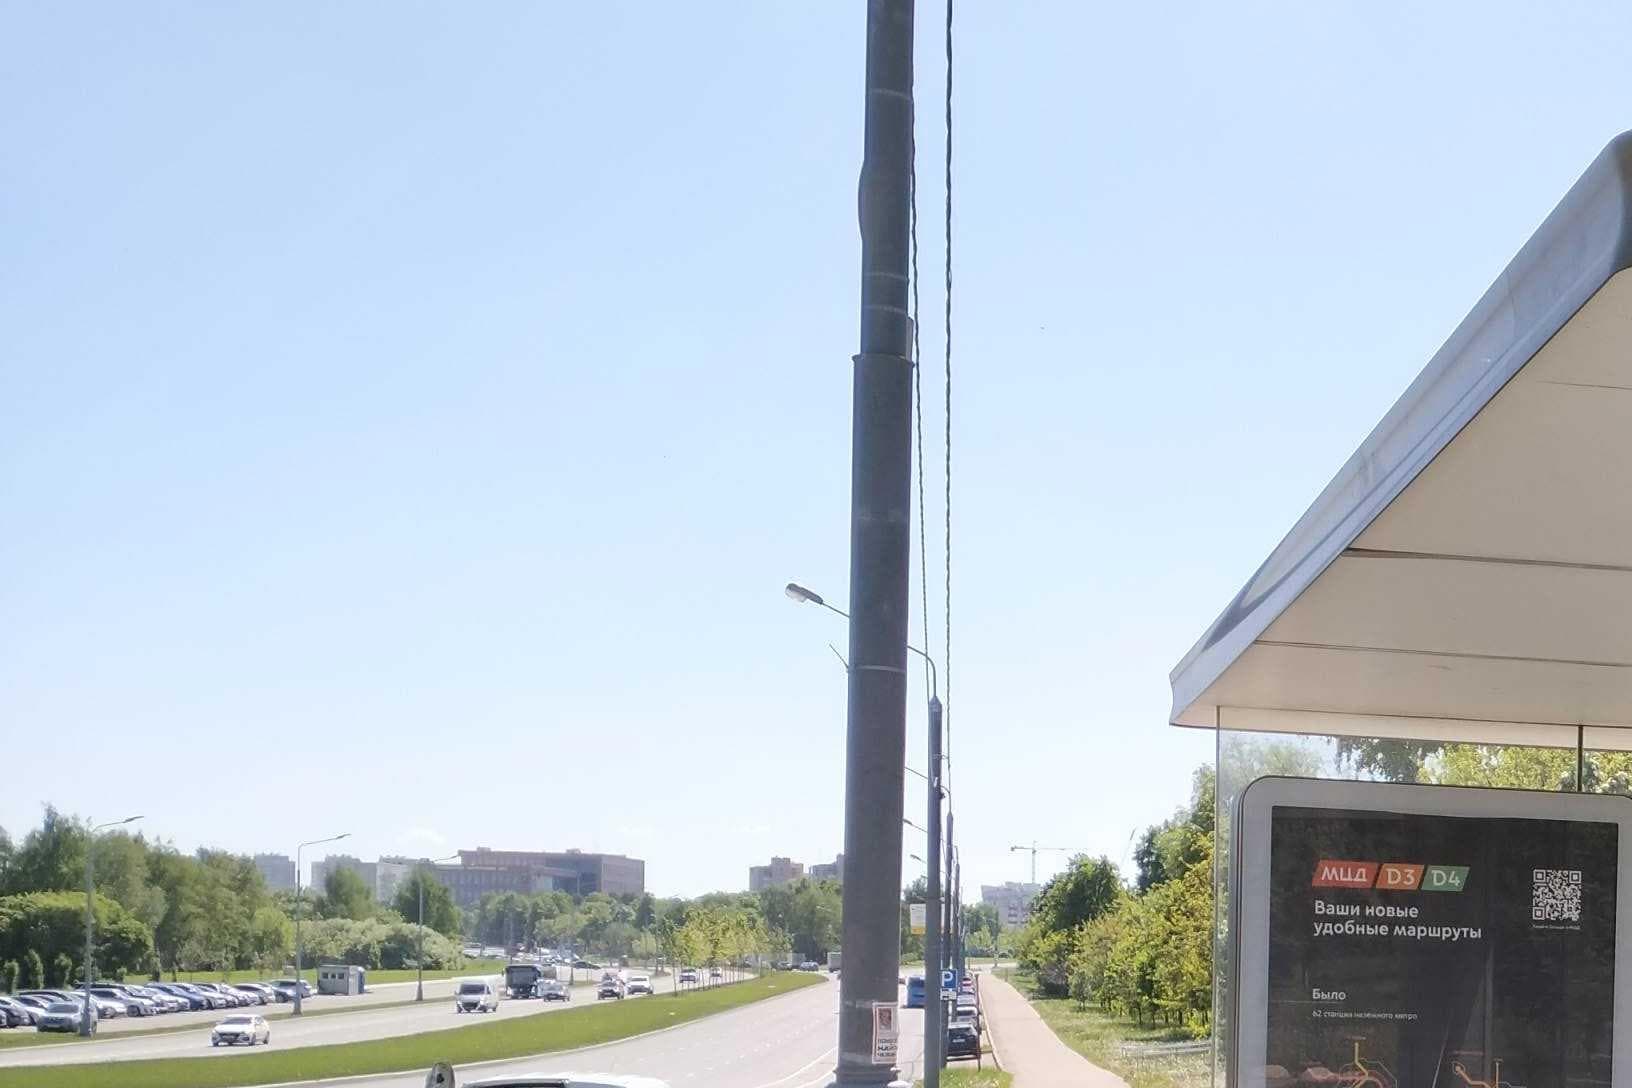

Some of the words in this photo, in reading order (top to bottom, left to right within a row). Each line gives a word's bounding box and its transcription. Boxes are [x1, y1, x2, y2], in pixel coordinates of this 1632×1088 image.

[1320, 866, 1367, 882] МЦД
[1385, 868, 1415, 885] D3
[1431, 869, 1460, 886] D4
[1314, 900, 1360, 916] Ваши
[1365, 905, 1419, 918] новые
[1313, 920, 1389, 936] удобные
[1393, 926, 1482, 941] маршруты
[942, 971, 953, 987] P
[1312, 988, 1346, 1000] Было
